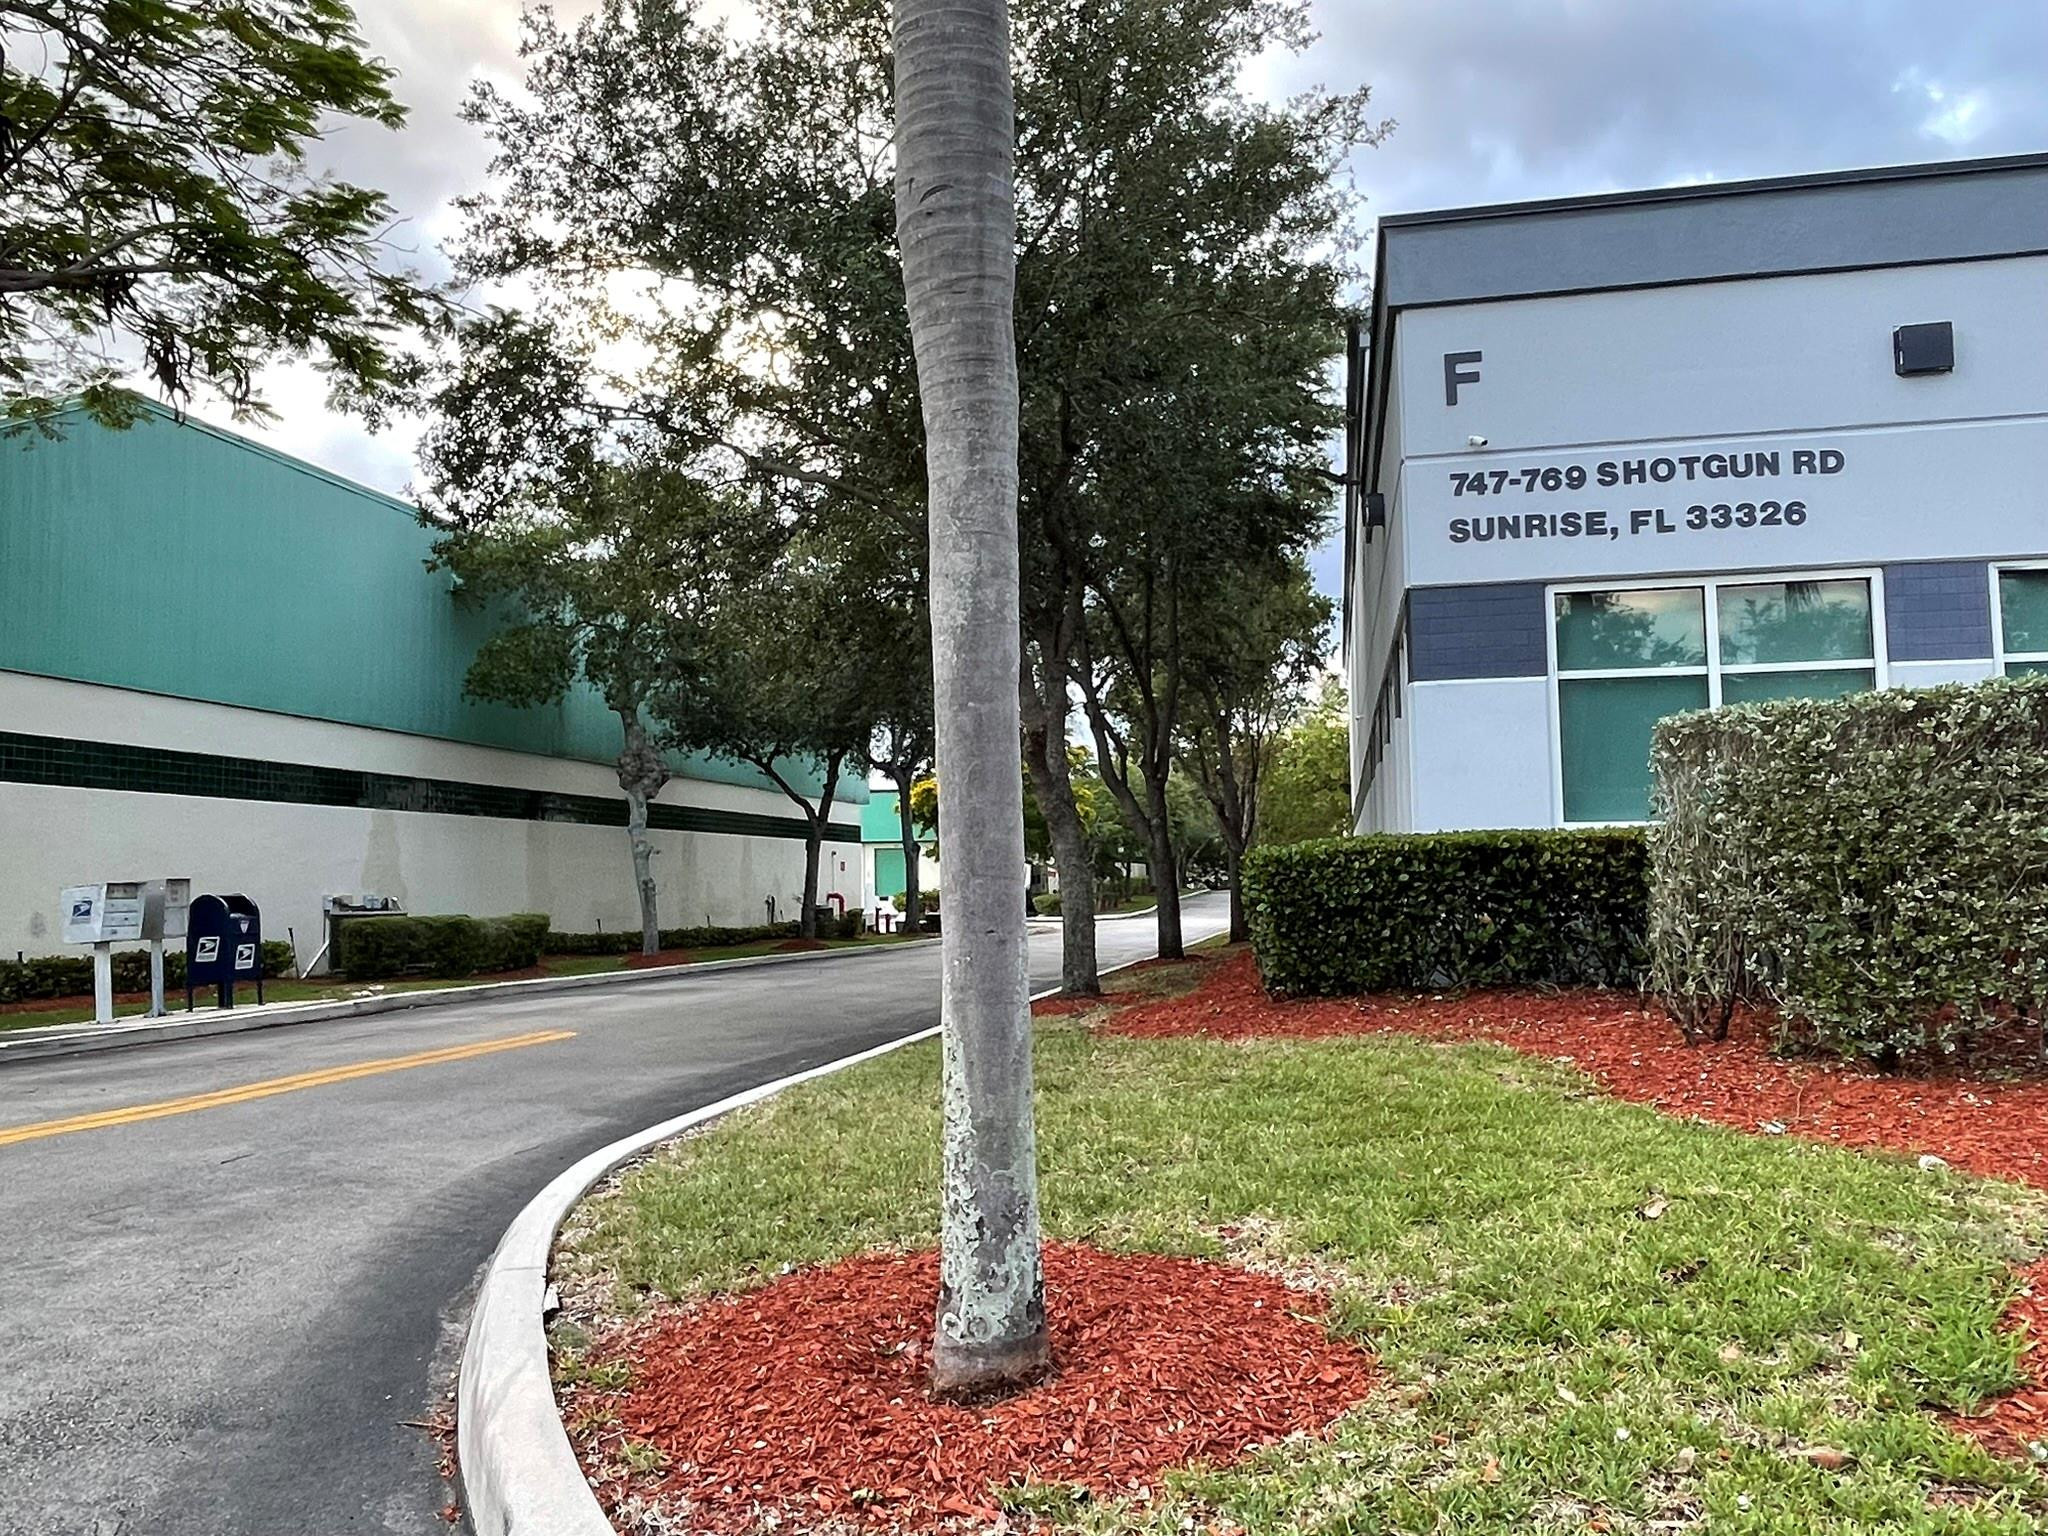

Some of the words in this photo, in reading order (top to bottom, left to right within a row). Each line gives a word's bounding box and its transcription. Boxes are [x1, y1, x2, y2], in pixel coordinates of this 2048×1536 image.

[1443, 350, 1483, 407] F
[1449, 465, 1587, 497] 747-769
[1596, 450, 1780, 487] SHOTGUN
[1792, 449, 1845, 475] RD
[1449, 511, 1619, 544] SUNRISE,
[1630, 508, 1676, 535] FL
[1685, 500, 1807, 530] 33326
